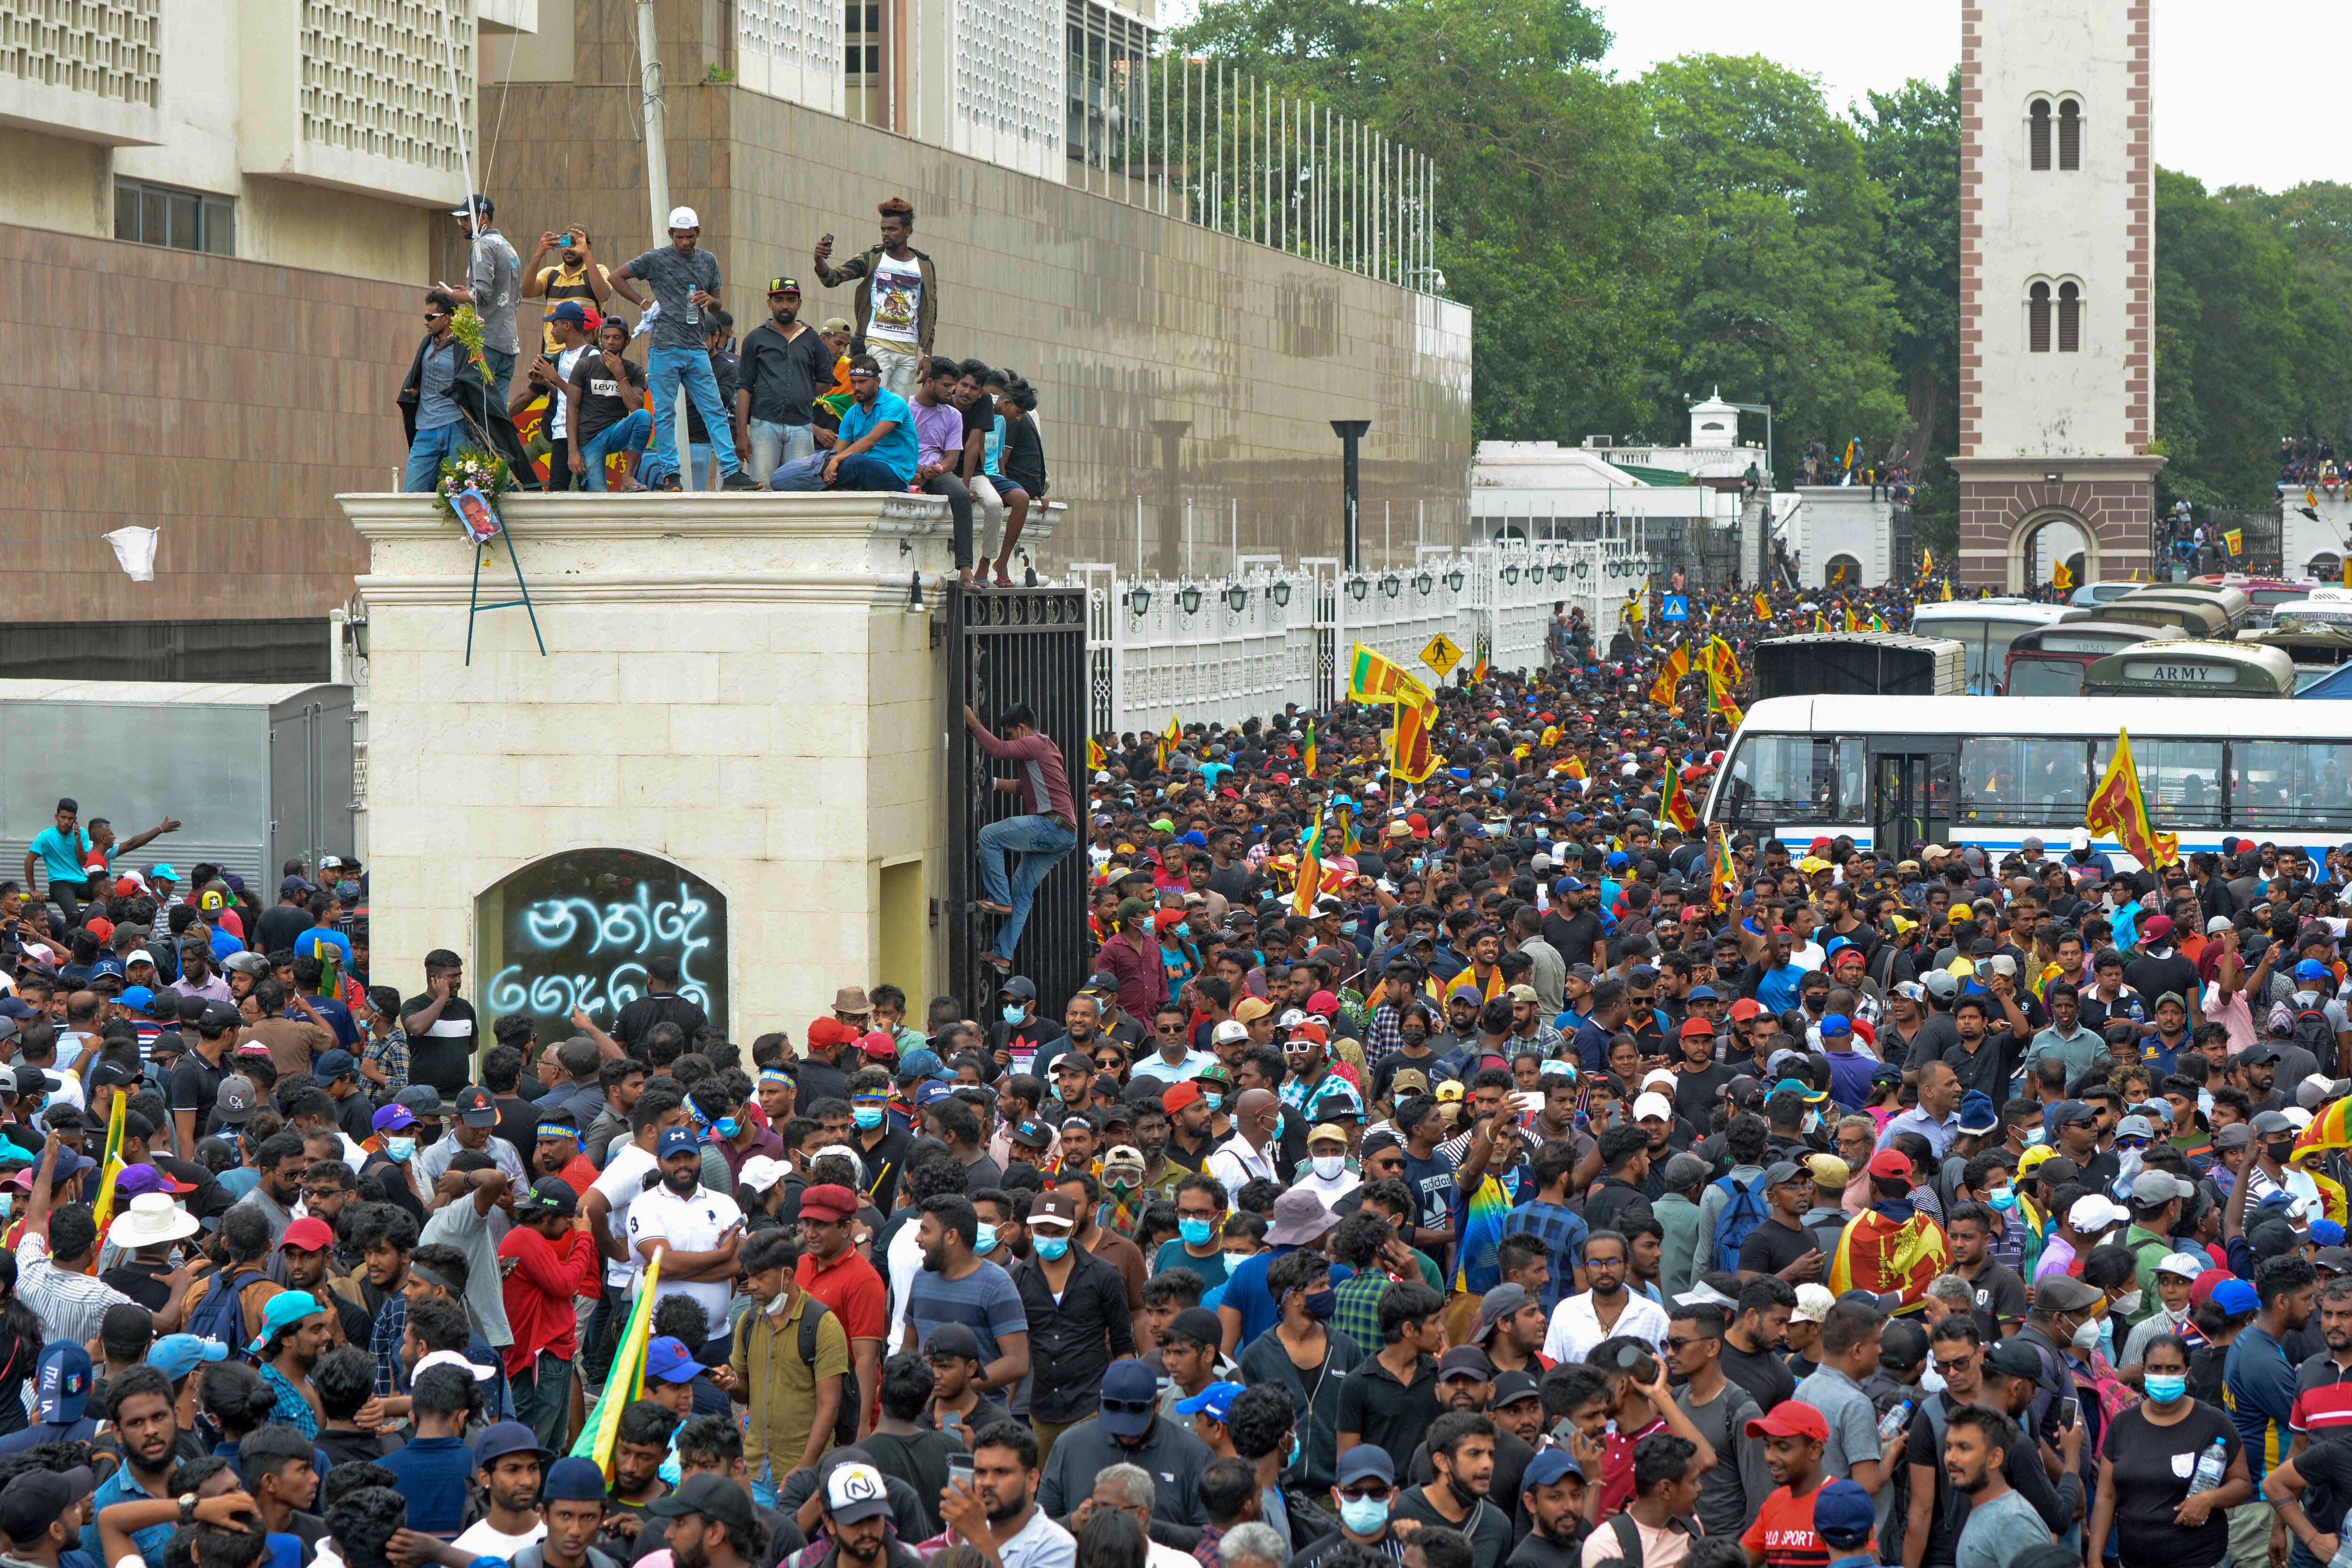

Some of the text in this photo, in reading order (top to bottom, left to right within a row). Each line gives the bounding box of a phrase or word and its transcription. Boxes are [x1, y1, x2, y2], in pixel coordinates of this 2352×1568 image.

[2128, 612, 2162, 621] ARMY
[2074, 643, 2108, 653] ARMY
[2153, 666, 2209, 681] ARMY
[102, 963, 113, 971] R
[548, 1126, 566, 1136] LANKA
[1422, 1177, 1451, 1190] addas
[630, 1216, 639, 1234] 3
